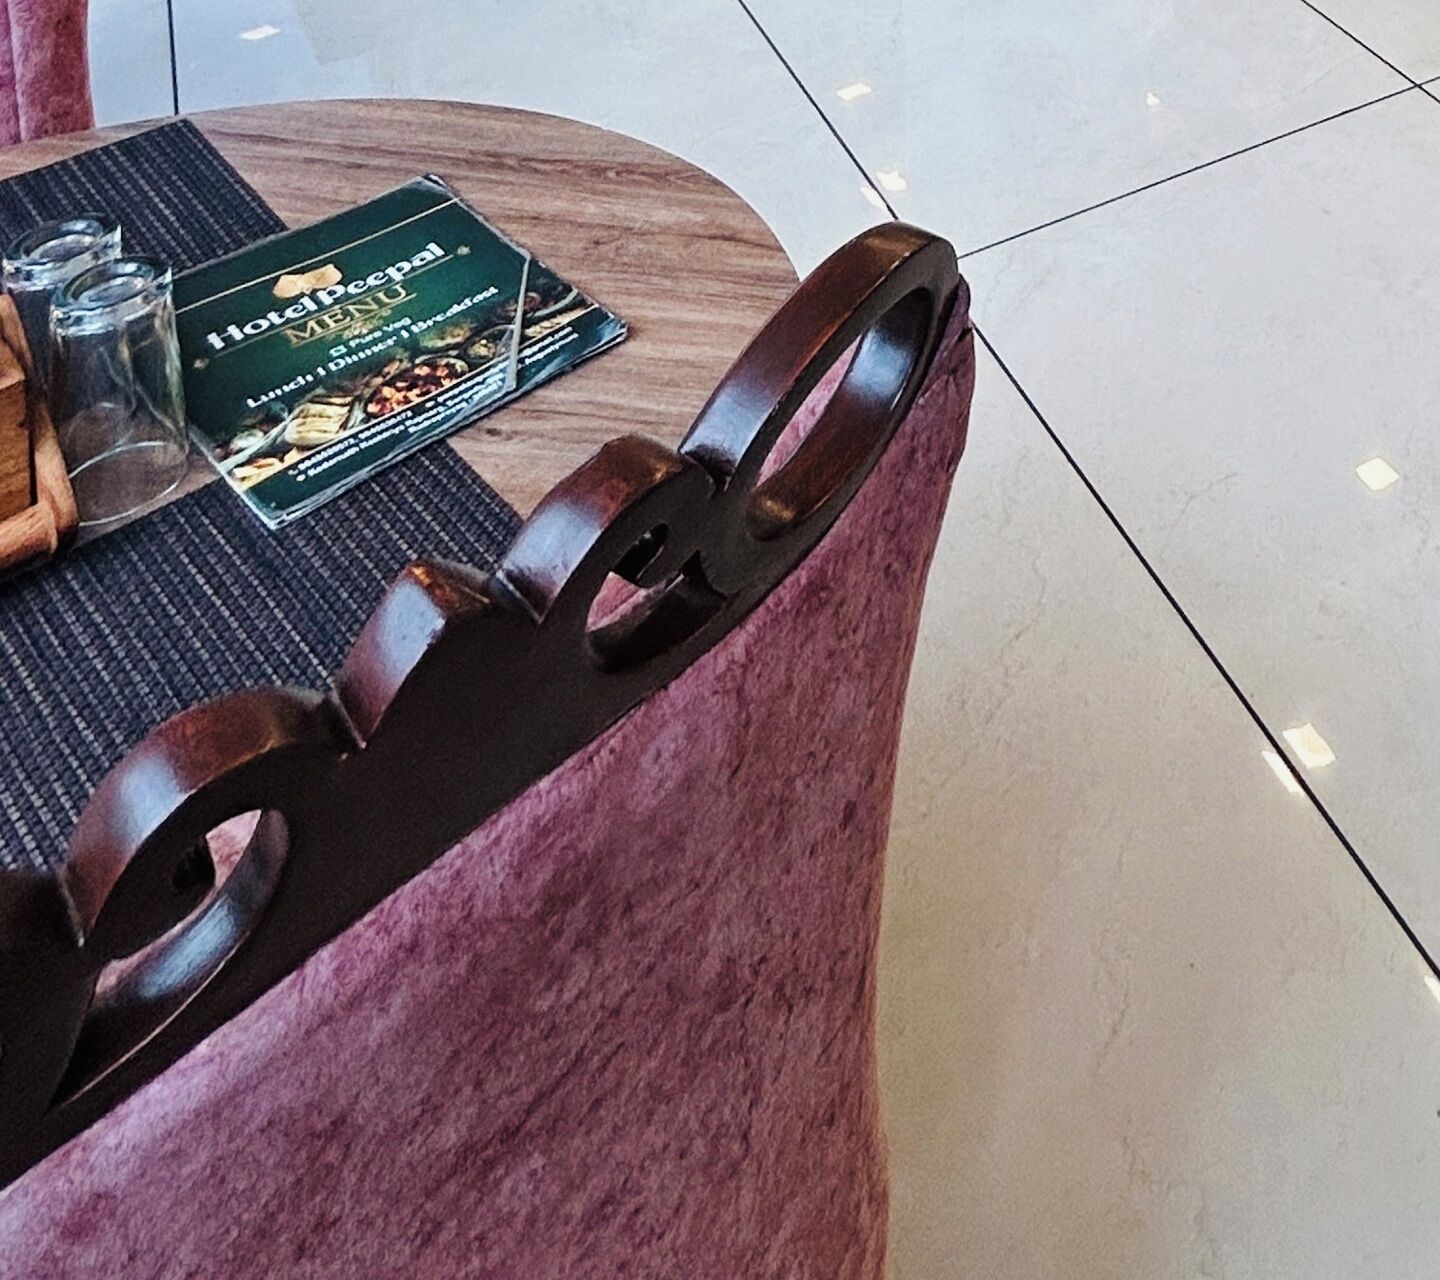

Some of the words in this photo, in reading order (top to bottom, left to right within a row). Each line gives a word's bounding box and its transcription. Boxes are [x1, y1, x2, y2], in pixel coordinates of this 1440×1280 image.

[285, 283, 407, 345] MENU
[349, 330, 383, 348] Pure
[382, 316, 412, 332] Veg
[246, 375, 314, 408] Lunch
[328, 336, 397, 371] Dinner
[410, 286, 499, 334] Breakfast
